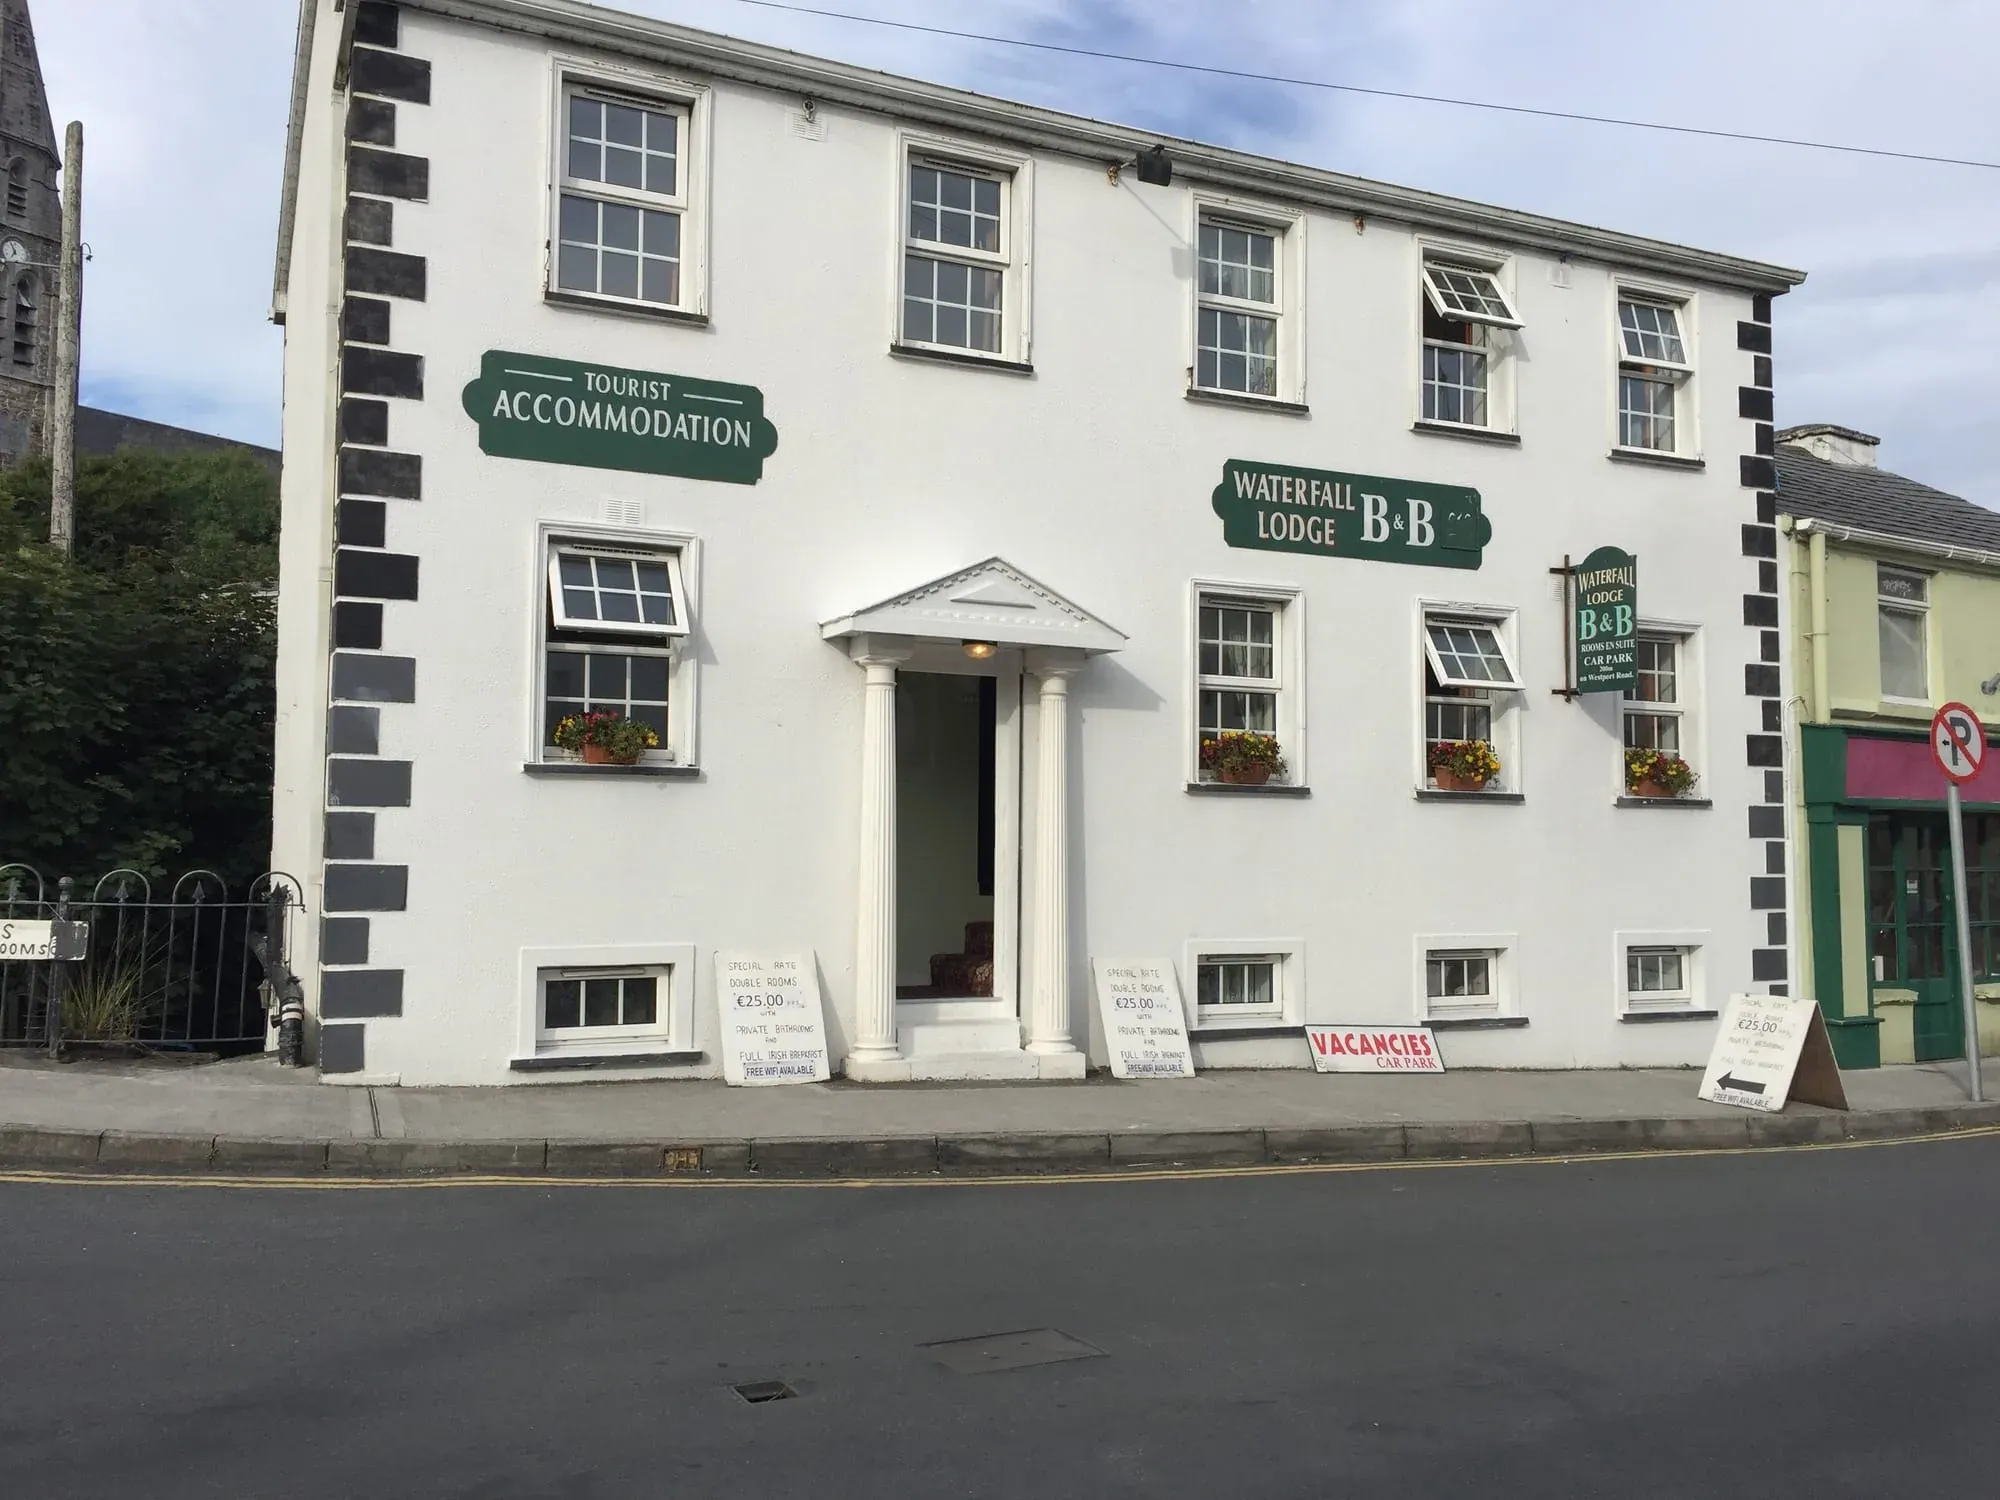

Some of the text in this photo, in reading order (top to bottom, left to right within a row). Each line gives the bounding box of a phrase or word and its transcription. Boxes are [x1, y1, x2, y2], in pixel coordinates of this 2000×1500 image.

[584, 371, 671, 401] TOURIST
[492, 389, 751, 448] ACCOMMODATION
[1233, 470, 1355, 511] WATERFALL
[1360, 492, 1435, 548] B&B
[1258, 510, 1335, 545] LODGE
[1578, 565, 1635, 594] WATERFALL
[1586, 589, 1624, 605] LODGE
[1581, 639, 1635, 652] ROOMS EN SUITE
[1584, 652, 1633, 666] CAR PARK
[728, 961, 796, 971] SPECIAL RATE
[730, 977, 798, 988] DOUBLE ROOMS
[737, 994, 784, 1007] €25.00
[1116, 997, 1154, 1009] €25.00
[736, 1025, 769, 1035] PRIVATE
[1738, 1019, 1778, 1033] €25.00
[1311, 1033, 1432, 1056] VACANCIES
[739, 1051, 763, 1061] FULL
[1376, 1056, 1438, 1069] CAR PARK
[746, 1065, 814, 1077] FREE WIFI AVAILABLE
